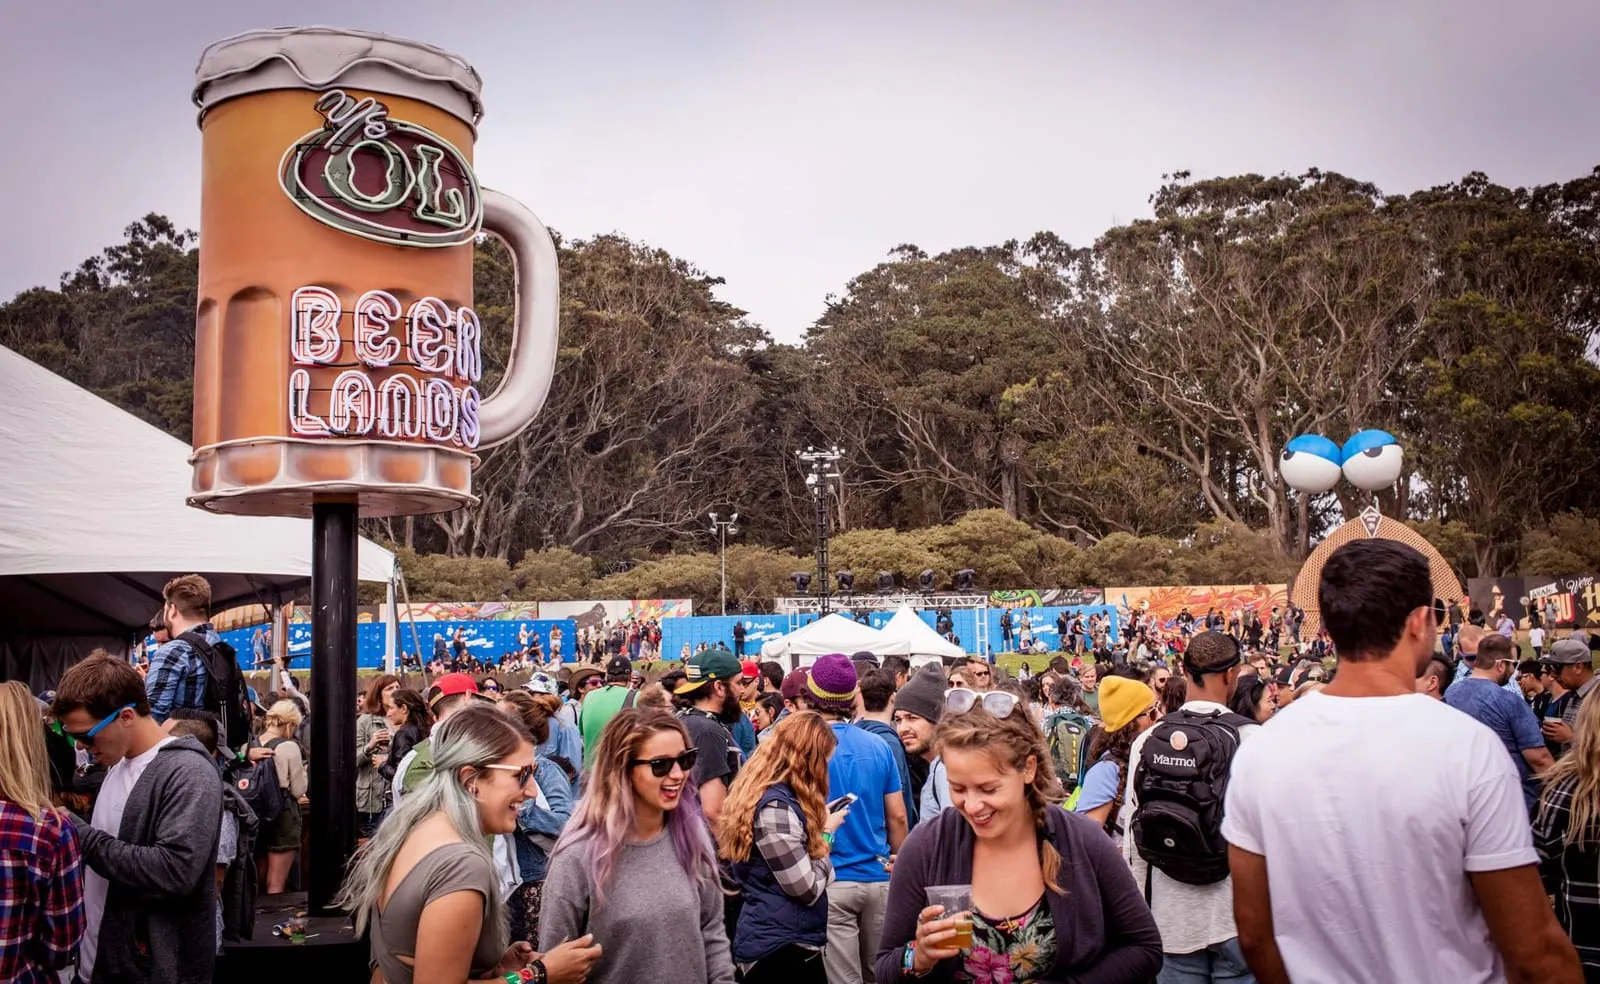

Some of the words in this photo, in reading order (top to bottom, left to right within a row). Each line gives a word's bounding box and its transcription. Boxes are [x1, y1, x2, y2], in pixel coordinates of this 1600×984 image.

[315, 89, 389, 150] Ye
[324, 139, 467, 229] OL
[290, 286, 481, 382] BEER
[288, 368, 481, 449] LANDS
[1153, 753, 1196, 768] Marmot
